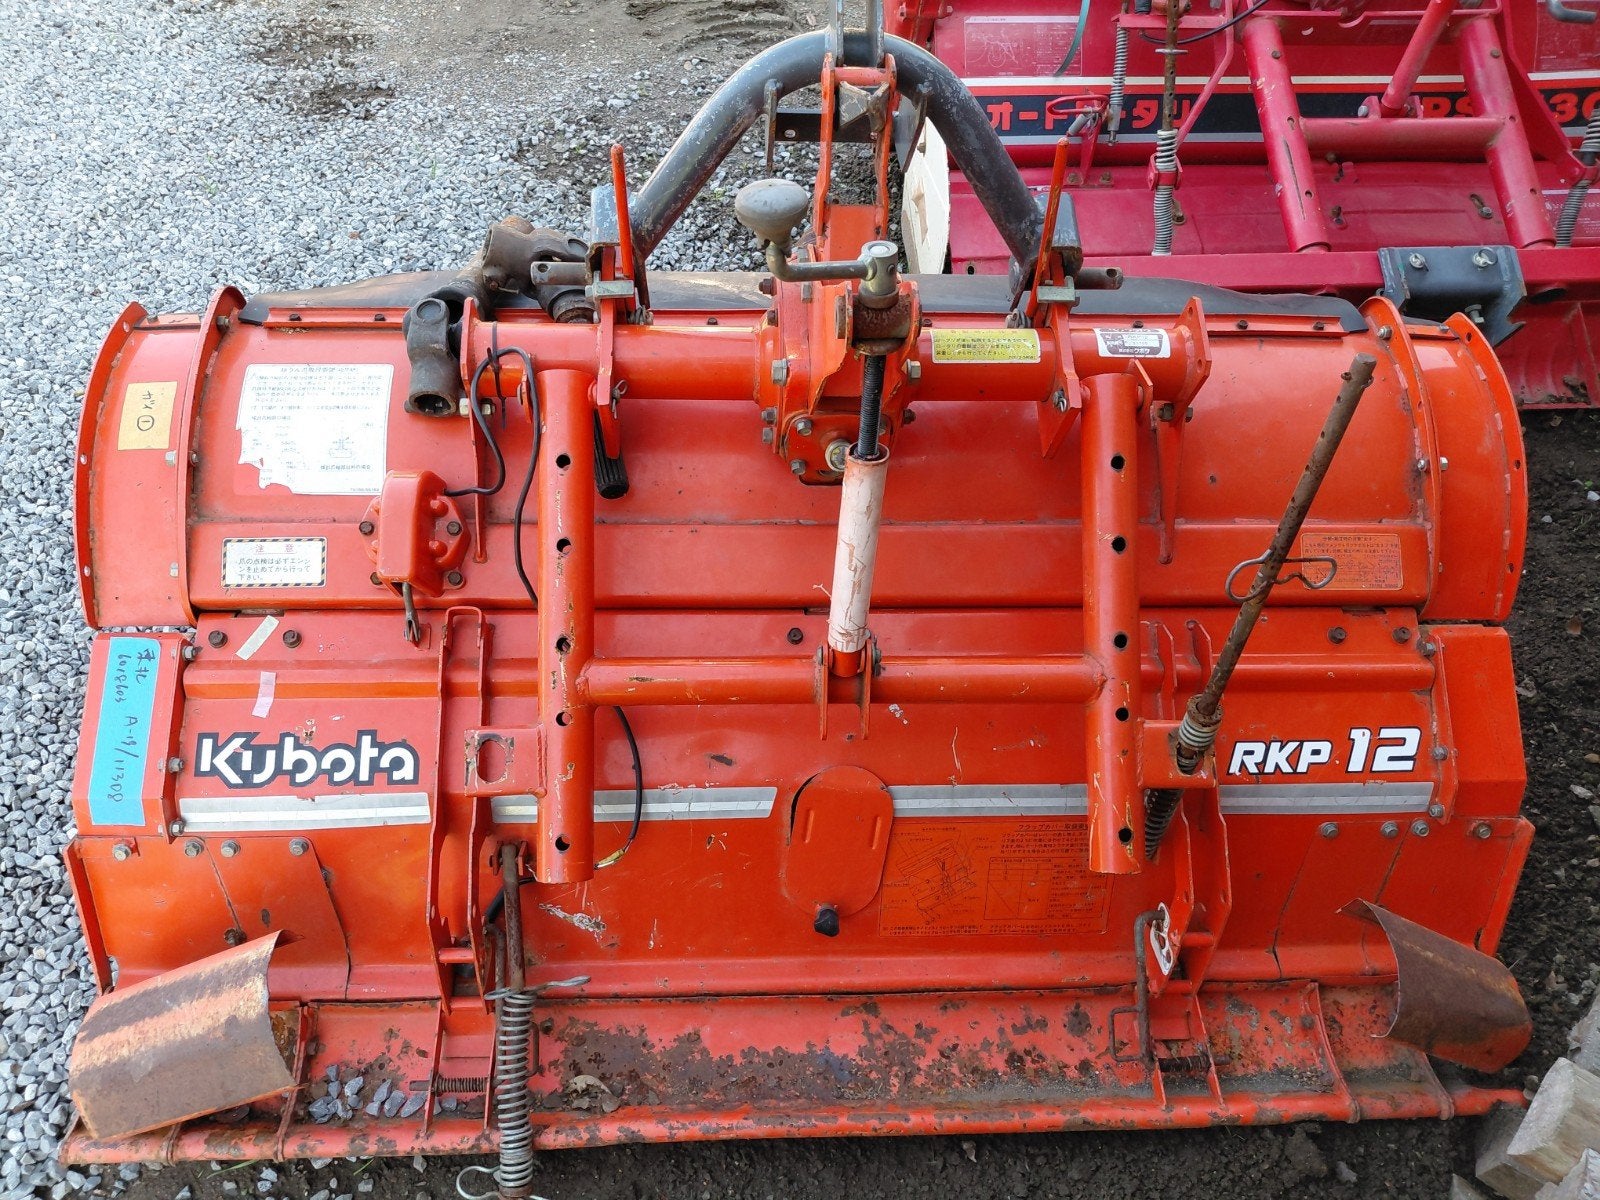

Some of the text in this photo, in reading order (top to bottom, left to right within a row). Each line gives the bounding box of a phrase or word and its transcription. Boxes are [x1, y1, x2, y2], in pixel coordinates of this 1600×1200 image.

[986, 99, 1191, 130] オートタリ
[198, 734, 416, 785] Kubota
[1228, 727, 1422, 774] RKP 12
